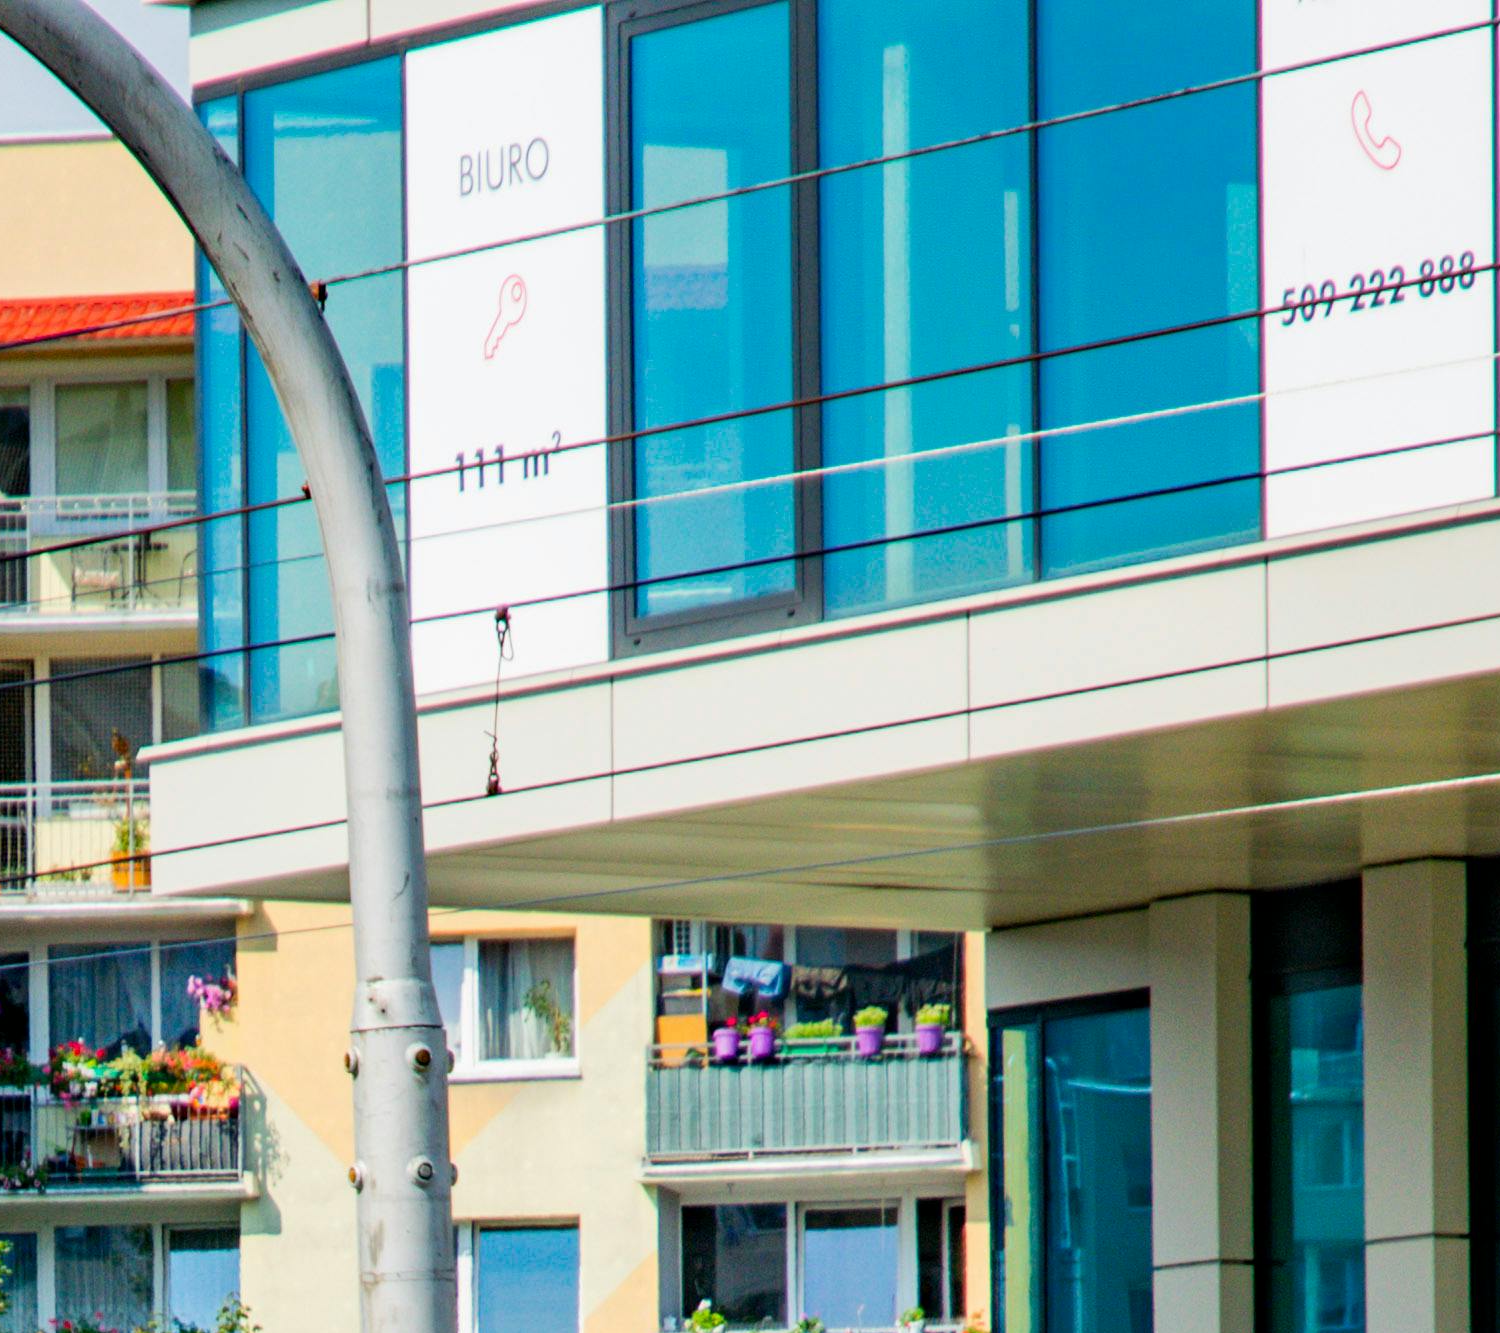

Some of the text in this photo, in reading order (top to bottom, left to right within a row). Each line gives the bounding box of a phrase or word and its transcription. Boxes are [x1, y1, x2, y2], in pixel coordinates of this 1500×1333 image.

[460, 137, 549, 197] BIURO
[1281, 250, 1476, 326] 509 222 888
[455, 444, 504, 492] 111
